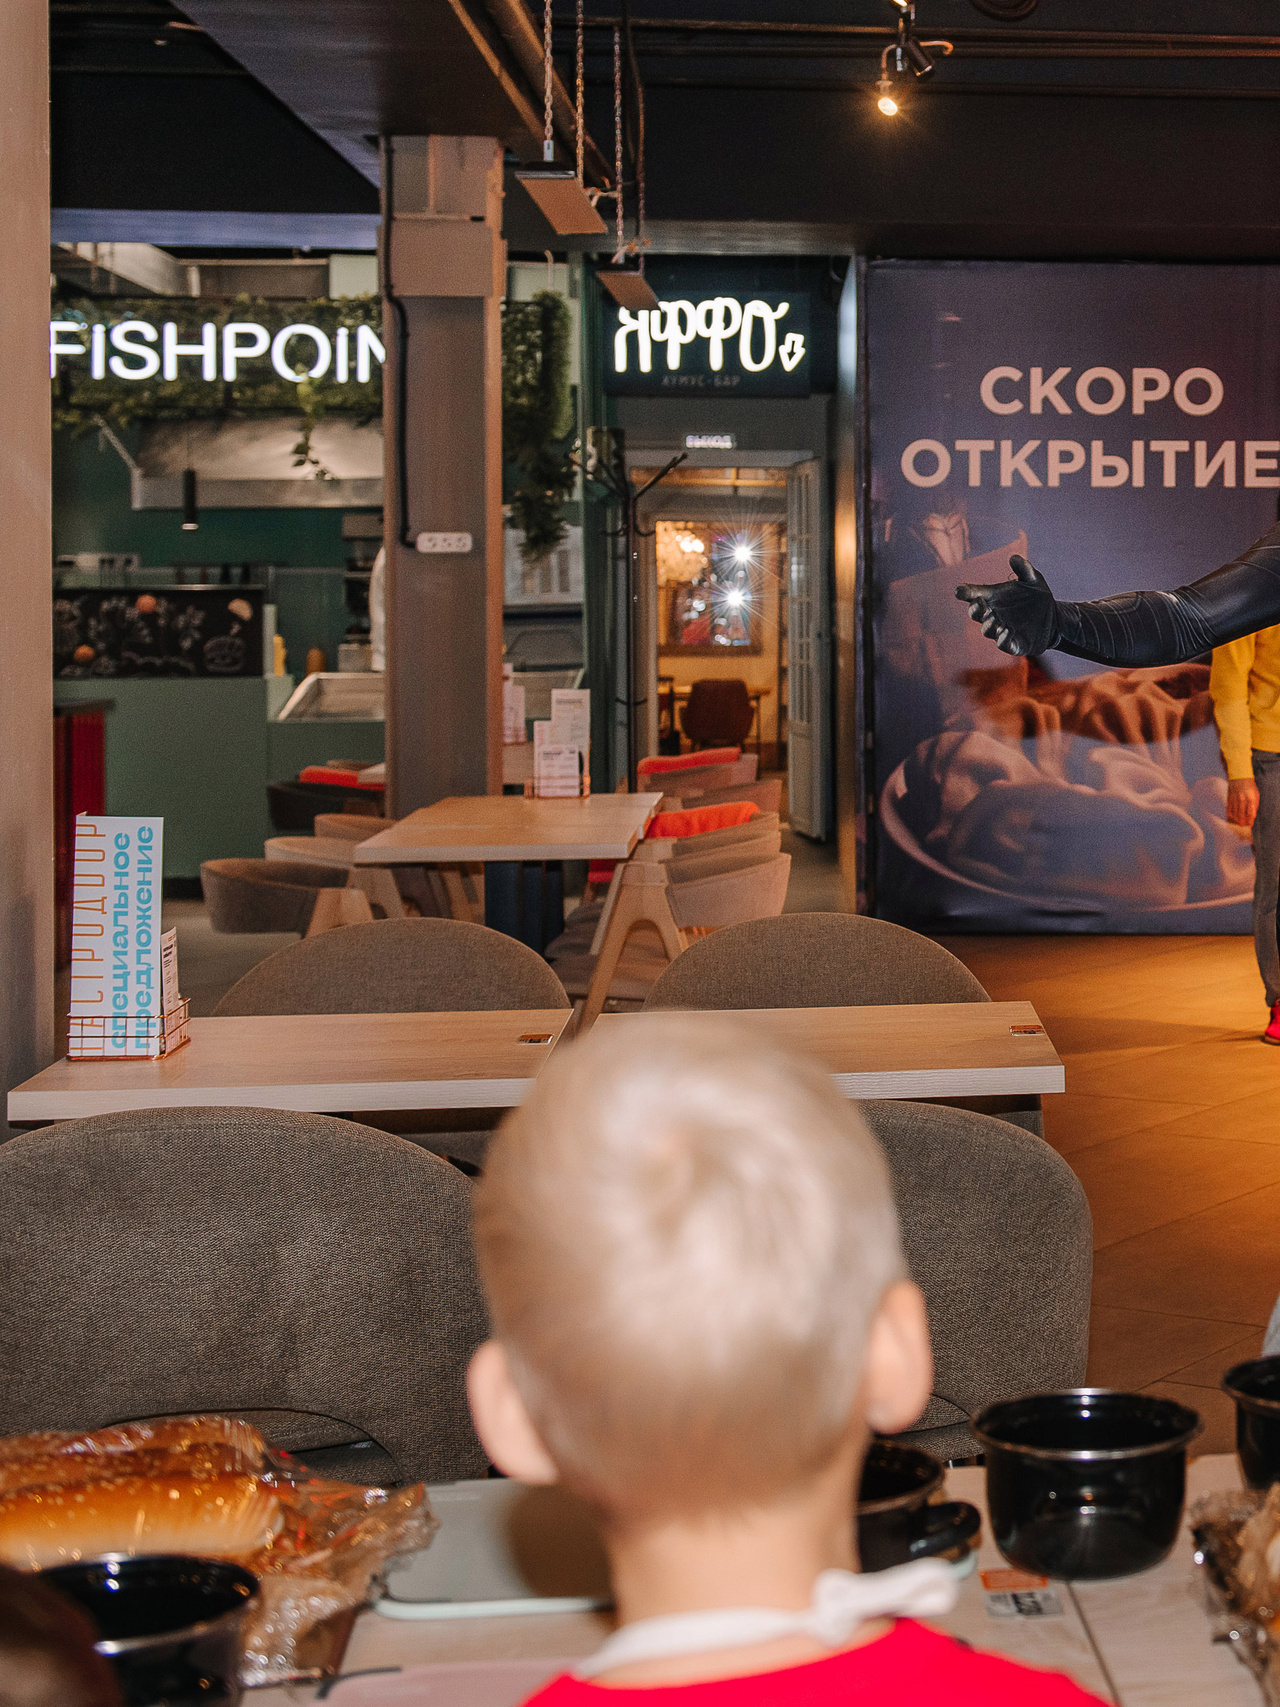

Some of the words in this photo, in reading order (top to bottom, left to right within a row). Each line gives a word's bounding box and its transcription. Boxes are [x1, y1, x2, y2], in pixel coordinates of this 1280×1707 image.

[979, 366, 1225, 416] СКОРО
[111, 832, 130, 1049] специальное
[135, 826, 156, 1049] предложение
